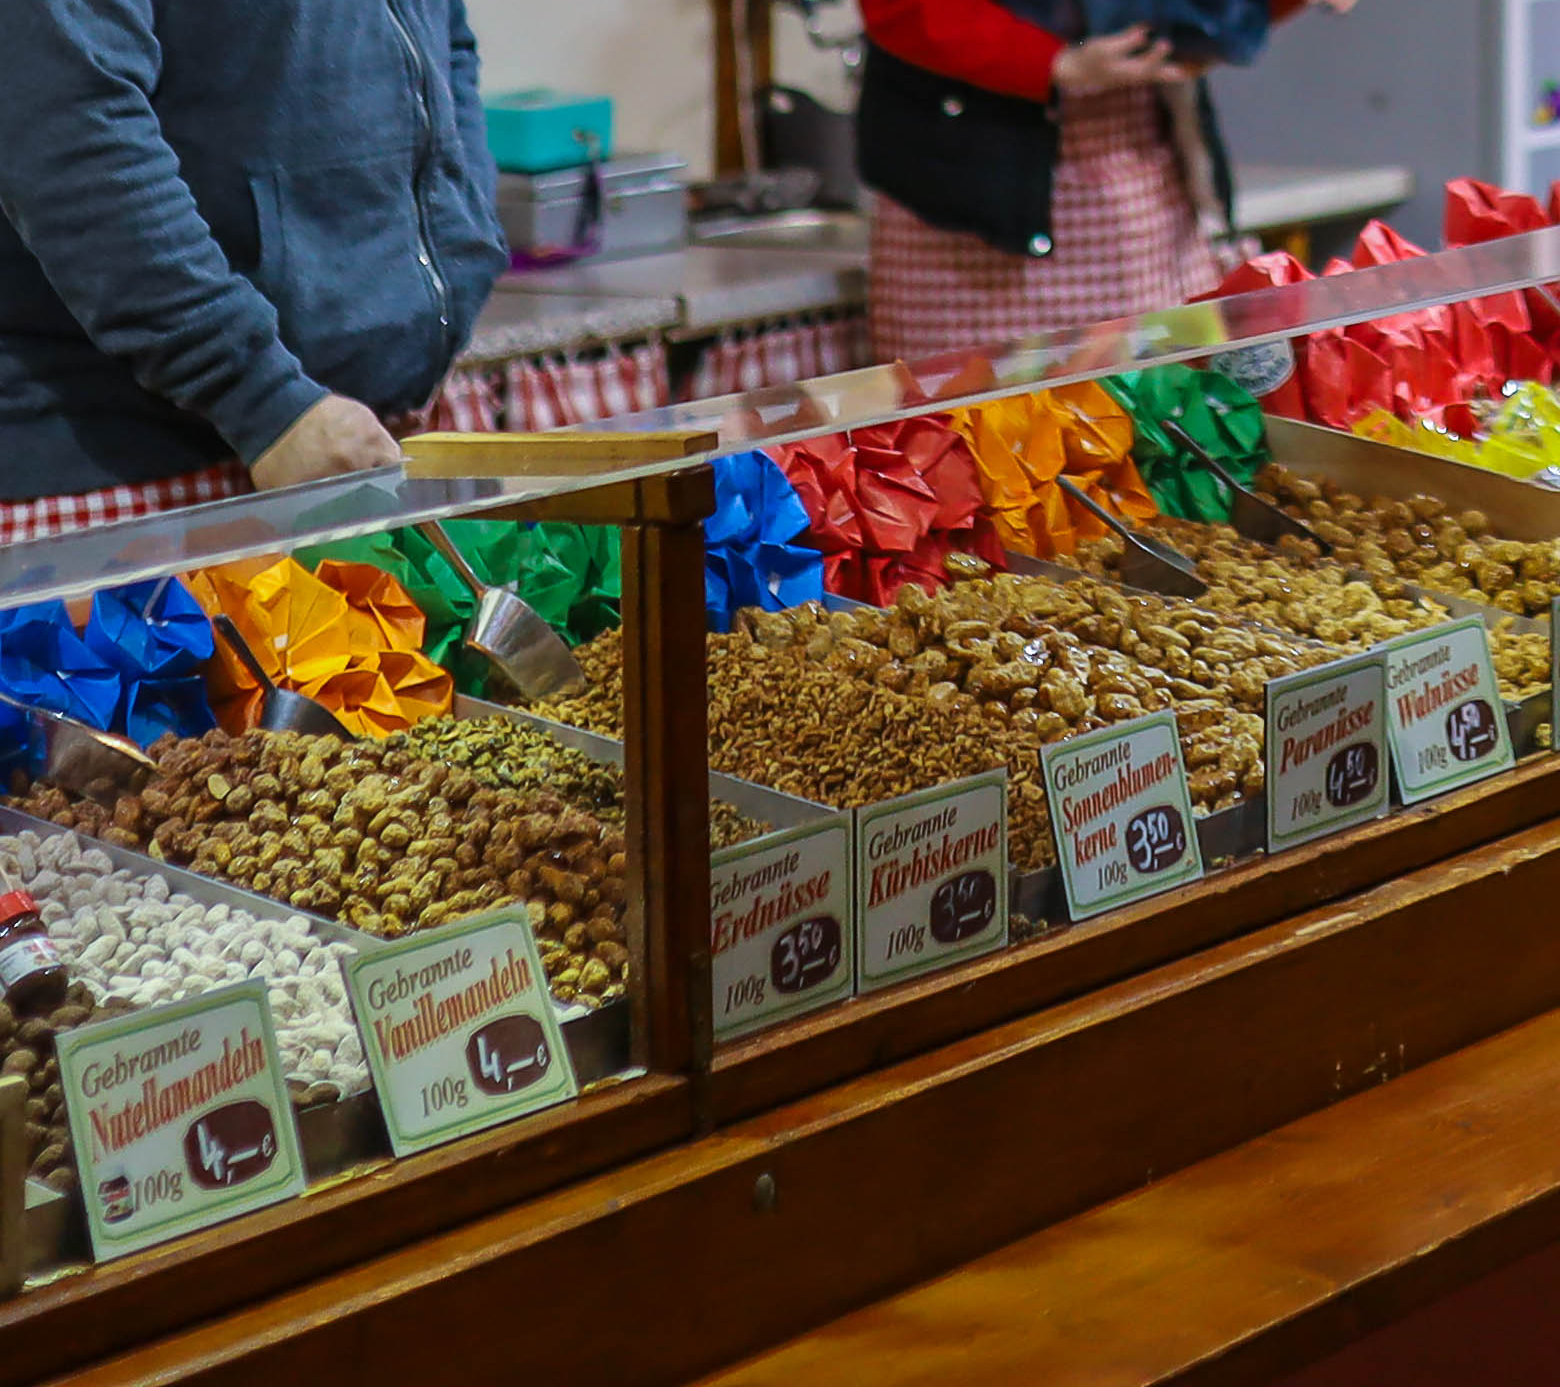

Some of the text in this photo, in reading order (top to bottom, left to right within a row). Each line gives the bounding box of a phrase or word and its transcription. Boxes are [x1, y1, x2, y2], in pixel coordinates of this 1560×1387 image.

[1277, 684, 1348, 732] Gebrannte
[1395, 662, 1481, 729] Walnüsse
[1054, 740, 1132, 792] Gebrannte
[1279, 699, 1375, 775] Paranüsse
[1060, 751, 1179, 835] Sonnenblumen-
[869, 805, 958, 860] Gebrannte
[1073, 821, 1118, 868] kerne
[867, 821, 1000, 909] Kürbiskerne
[1097, 861, 1128, 891] 100g
[711, 869, 831, 955] Erdnüsse
[886, 923, 927, 961] 100g
[368, 948, 473, 1011] Gebrannte
[372, 948, 533, 1066] Vanillemandeln
[725, 976, 767, 1015] 100g
[81, 1027, 203, 1099] Gebrannte
[88, 1028, 265, 1163] Nutellamandeln
[420, 1075, 468, 1119] 100g
[132, 1170, 184, 1213] 100g
